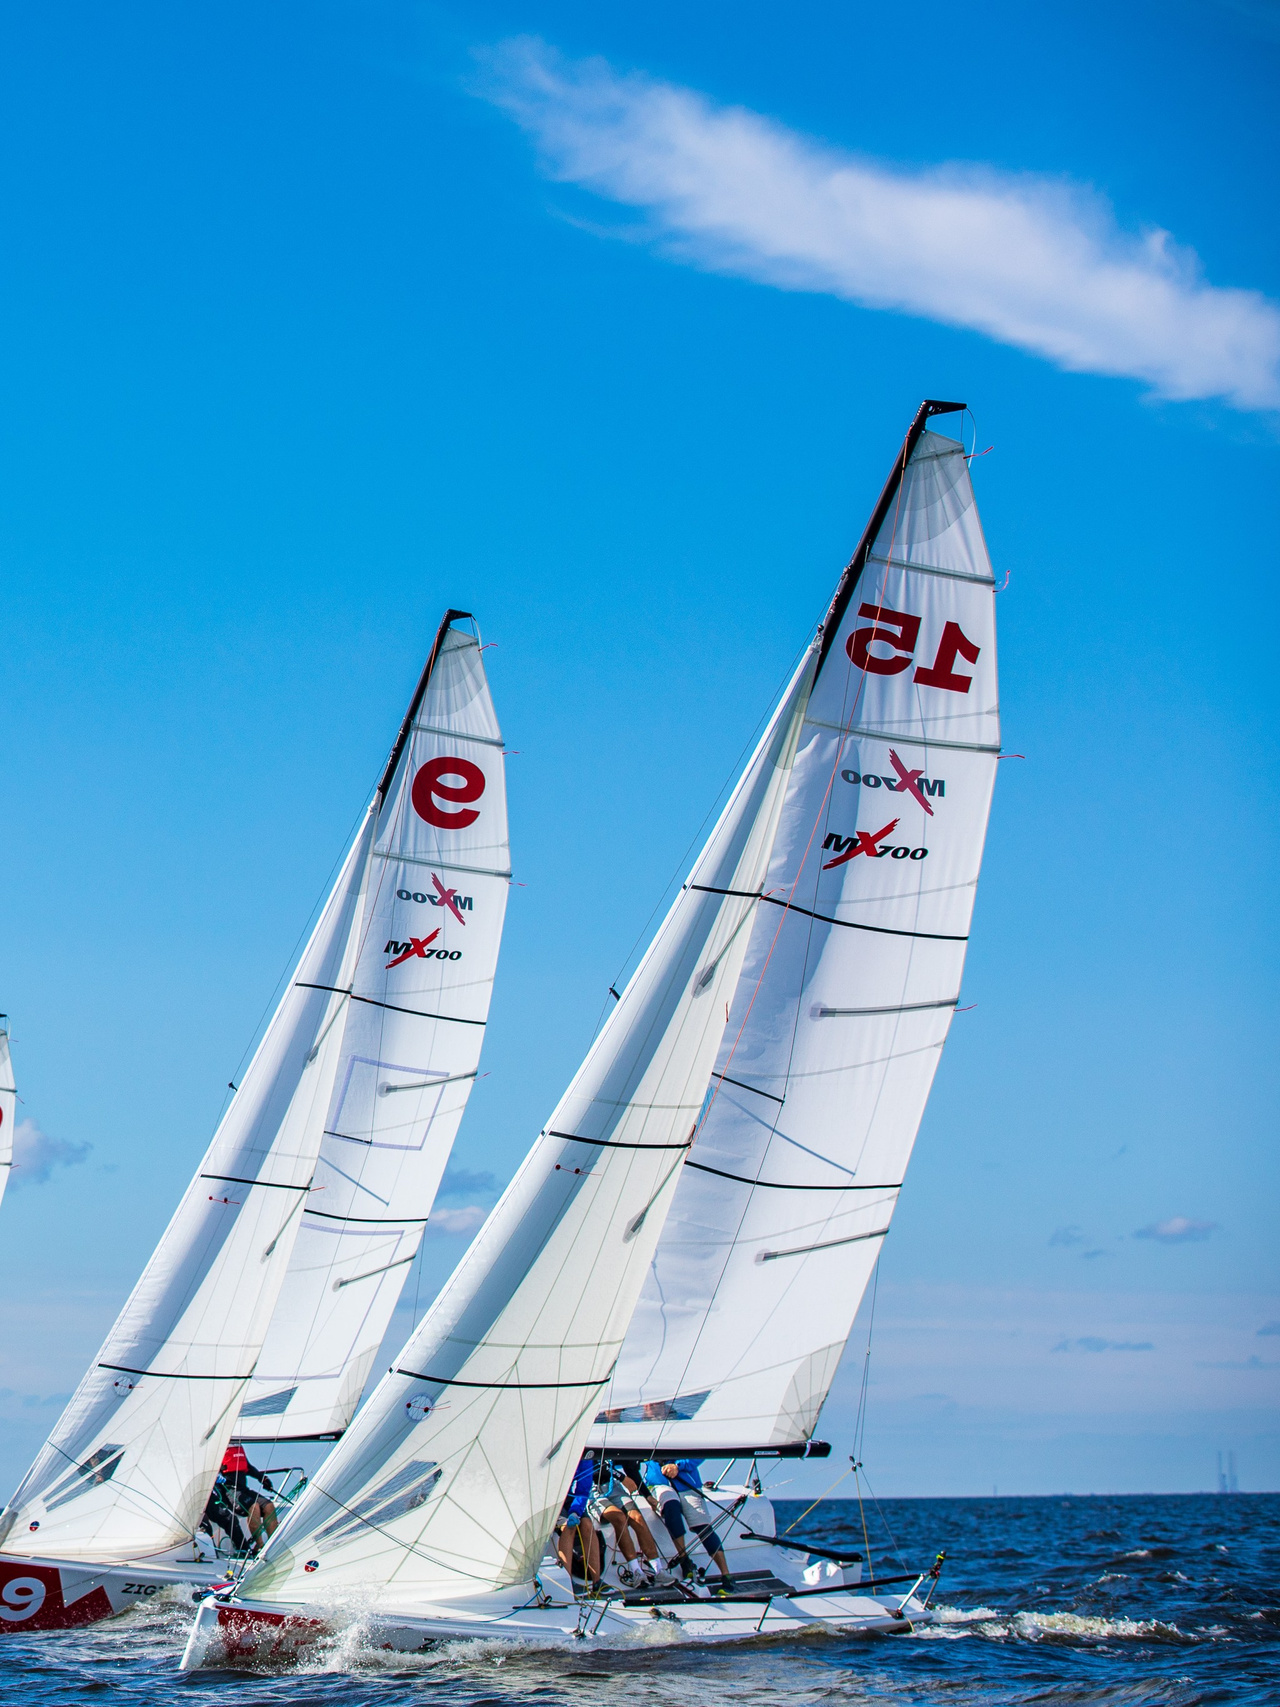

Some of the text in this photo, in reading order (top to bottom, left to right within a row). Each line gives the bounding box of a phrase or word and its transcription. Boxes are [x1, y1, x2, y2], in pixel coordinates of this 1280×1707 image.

[821, 817, 929, 871] MX700
[383, 927, 463, 970] MX700
[121, 1583, 164, 1596] ZIG
